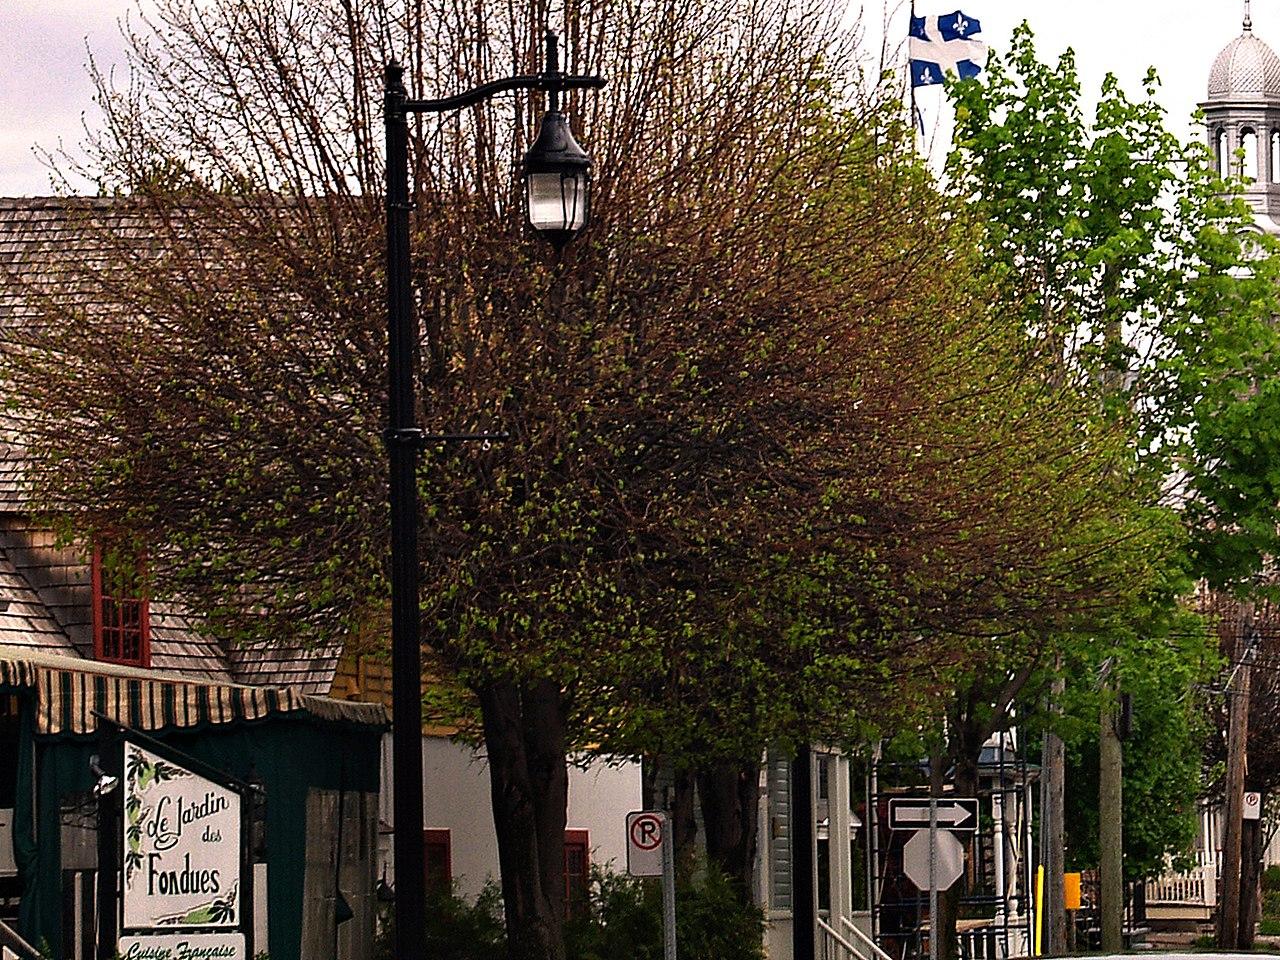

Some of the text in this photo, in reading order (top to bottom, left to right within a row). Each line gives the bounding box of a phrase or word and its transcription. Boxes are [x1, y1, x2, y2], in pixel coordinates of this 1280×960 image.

[147, 792, 229, 841] Le Jardin
[202, 825, 222, 842] des
[148, 852, 220, 896] Fondues
